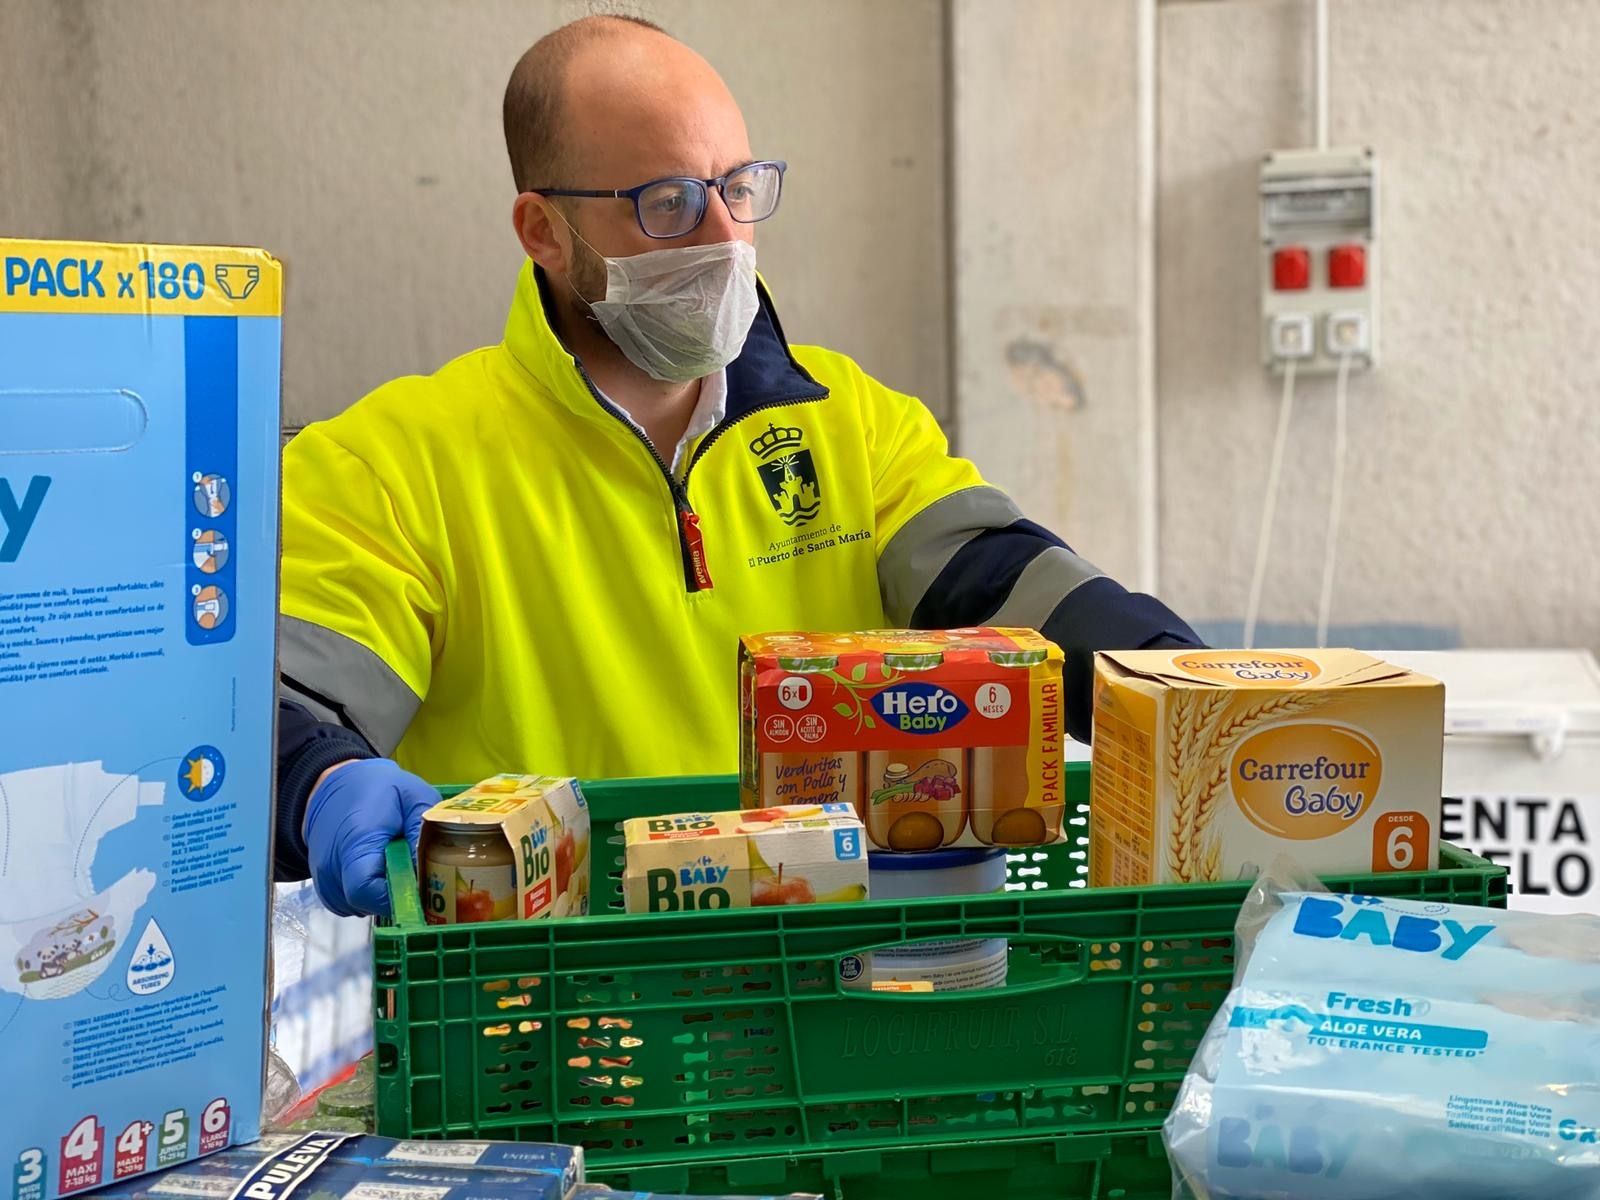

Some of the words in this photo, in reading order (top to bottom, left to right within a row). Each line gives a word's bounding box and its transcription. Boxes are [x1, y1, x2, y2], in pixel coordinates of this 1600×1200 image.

[5, 257, 105, 297] PACK
[769, 528, 827, 552] Ayuntamiento
[830, 523, 842, 533] de
[748, 558, 756, 568] El
[757, 551, 790, 566] Puerto
[792, 546, 804, 557] de
[807, 539, 836, 553] Santa
[838, 529, 871, 545] María
[1181, 660, 1304, 670] Carrefour
[883, 689, 957, 714] Hero
[988, 686, 997, 703] 6
[983, 704, 1004, 713] MESES
[1041, 682, 1058, 755] FAMILIAR
[773, 719, 785, 729] SIN
[805, 716, 818, 726] SIN
[900, 713, 947, 731] Baby
[776, 756, 842, 779] Verduritas
[1239, 756, 1370, 782] Carrefour
[776, 783, 798, 796] con
[803, 771, 834, 791] Pollo
[839, 774, 847, 793] y
[1041, 760, 1059, 803] PACK
[1388, 815, 1414, 824] DESDE
[842, 837, 853, 852] 6
[1387, 826, 1415, 870] 6
[680, 866, 730, 887] BABY
[1293, 896, 1497, 960] BABY
[1327, 992, 1412, 1017] Fresh
[1319, 1020, 1368, 1036] ALOE
[1373, 1025, 1422, 1041] VERA
[1307, 1035, 1406, 1054] TOLERANCE
[1449, 1095, 1493, 1106] Lingettes
[1530, 1104, 1552, 1113] Vera
[1485, 1107, 1504, 1115] met
[1529, 1111, 1552, 1121] Vera
[204, 1100, 226, 1132] 6
[1528, 1119, 1551, 1129] Vera
[118, 1122, 154, 1154] 4+
[162, 1110, 185, 1145] 5
[206, 1131, 228, 1143] LARGE
[1528, 1127, 1551, 1138] Vera
[64, 1117, 98, 1161] 4
[160, 1142, 187, 1155] JUNIOR
[18, 1148, 43, 1185] 3
[65, 1162, 97, 1179] MAXI
[244, 1138, 336, 1200] PULEVA
[85, 1174, 97, 1184] kg
